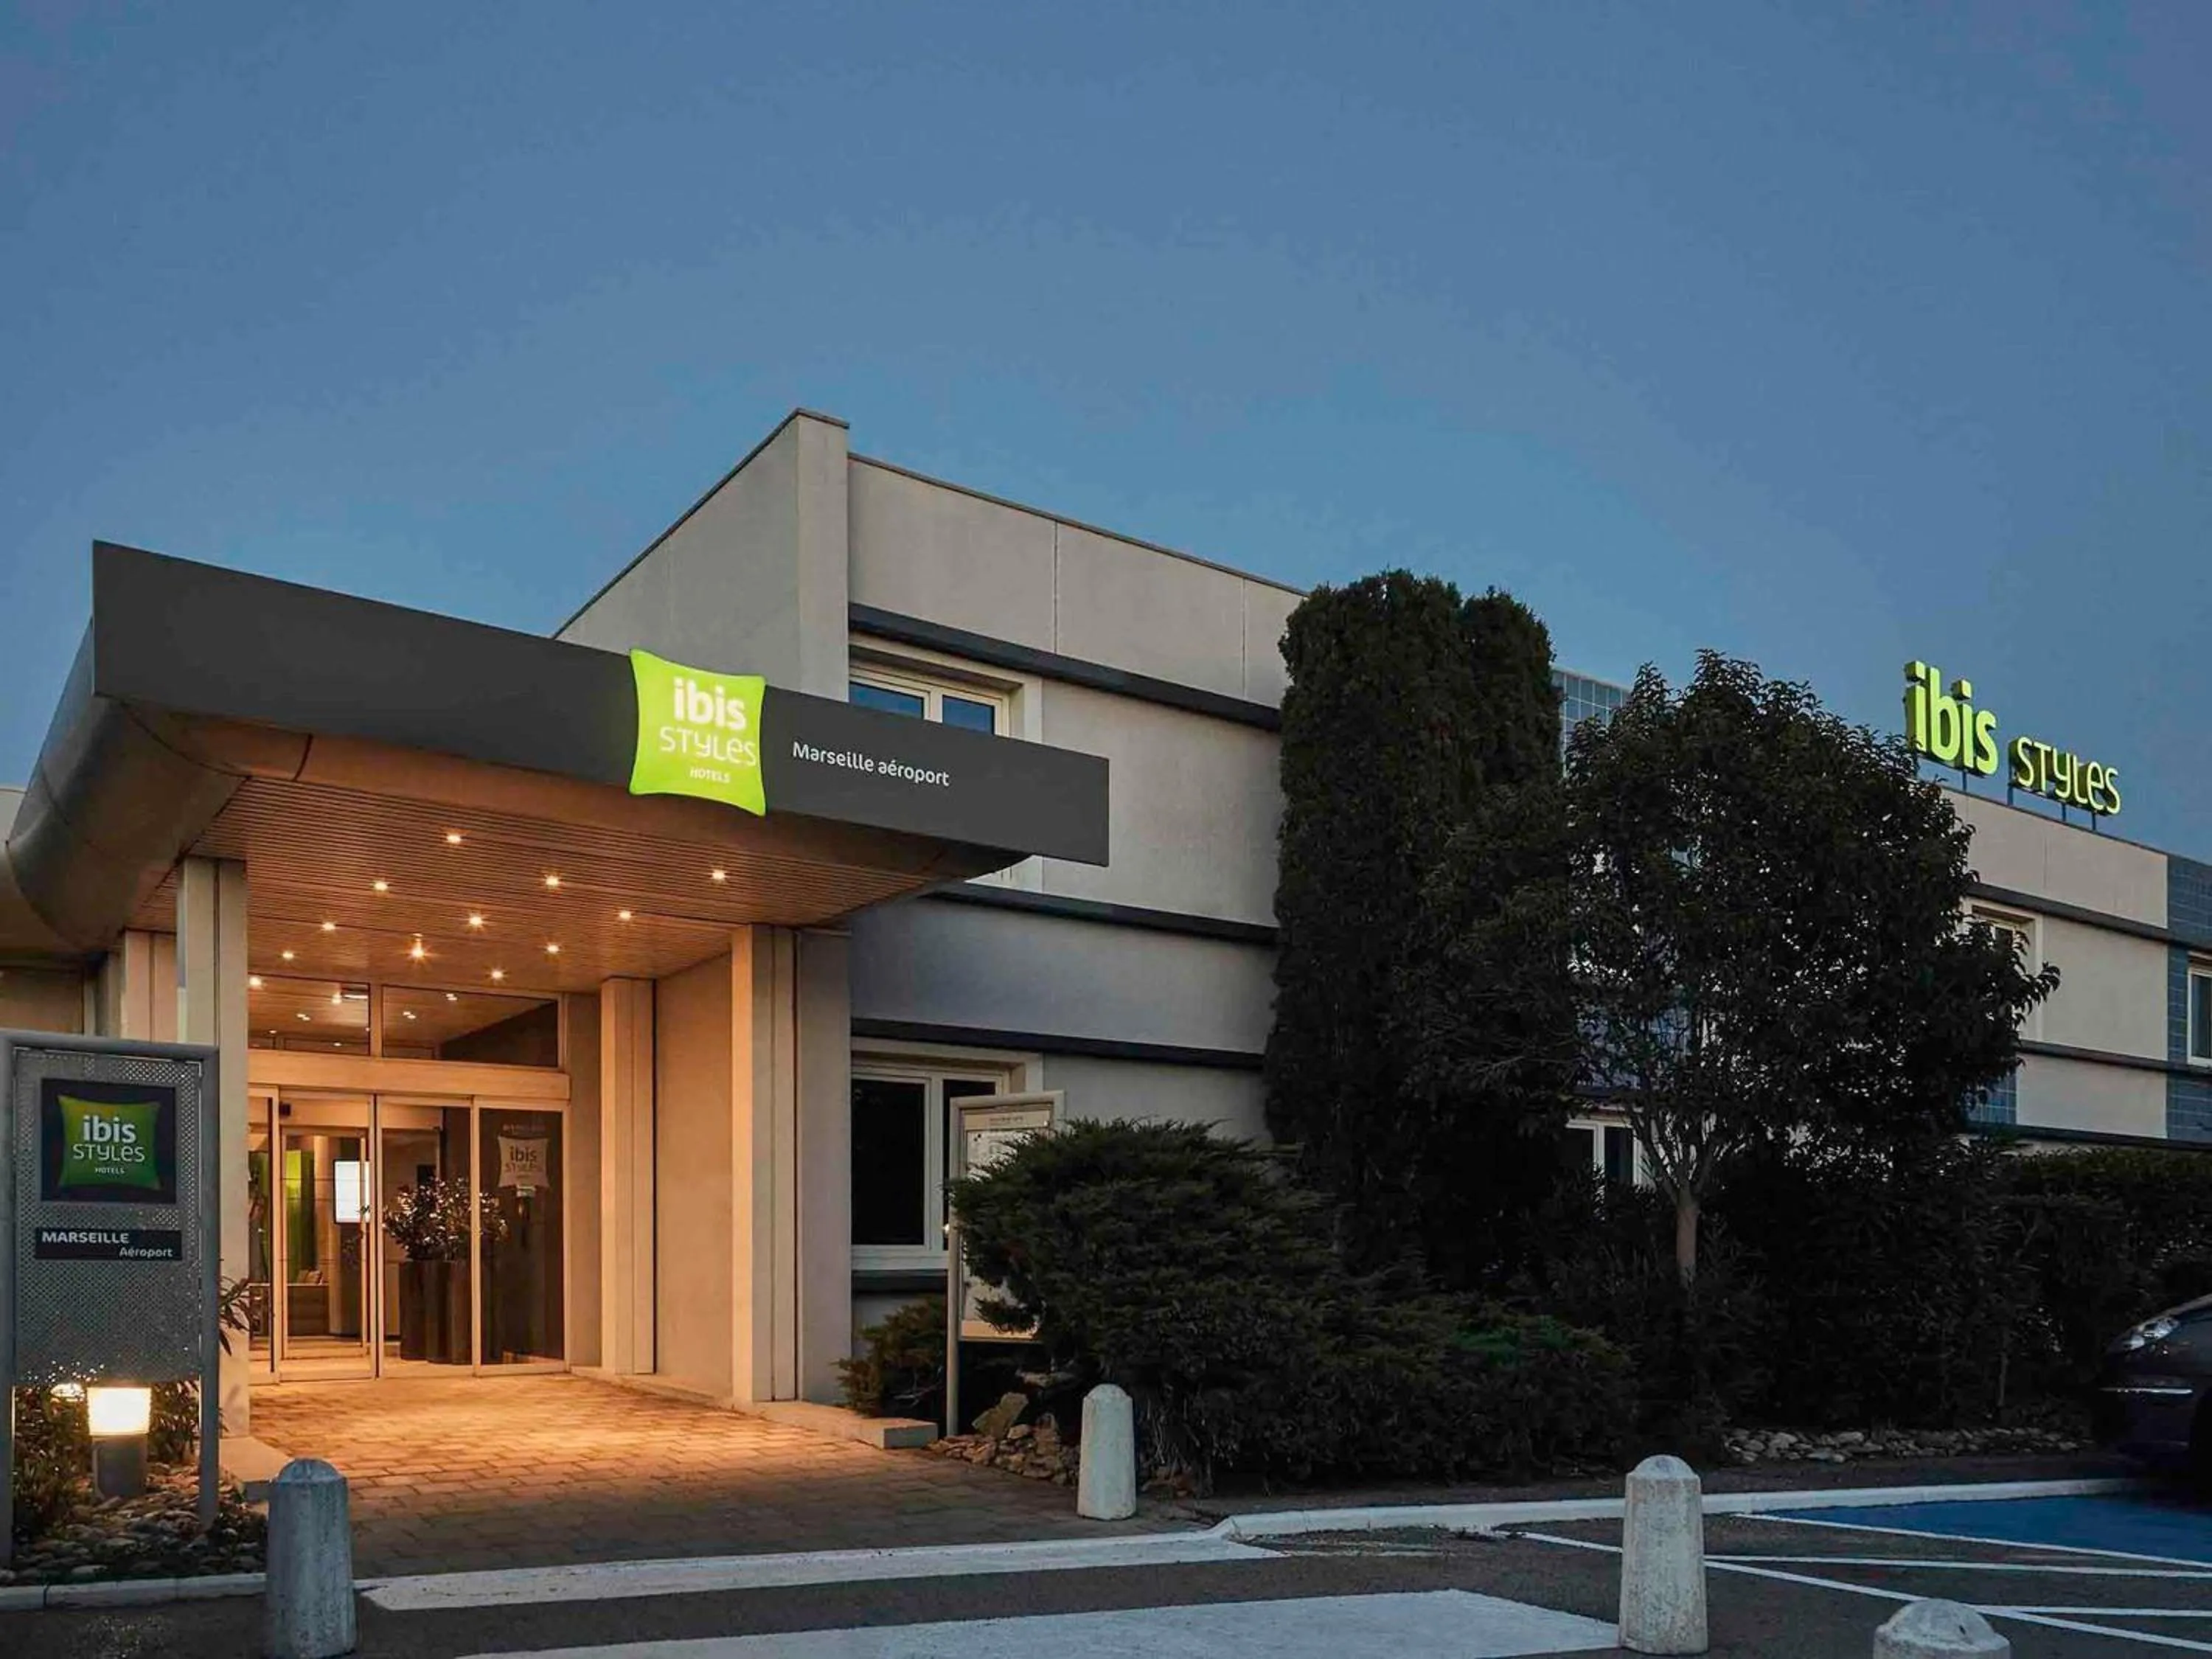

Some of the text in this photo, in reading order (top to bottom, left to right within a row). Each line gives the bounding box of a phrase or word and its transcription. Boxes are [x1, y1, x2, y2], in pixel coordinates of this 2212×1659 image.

[674, 676, 746, 731] ibis
[1905, 661, 1999, 775] ibis
[690, 767, 730, 784] HOTELS
[793, 741, 950, 787] Marseille aéroport
[83, 1115, 136, 1144] ibis
[509, 1146, 537, 1163] ibis
[42, 1231, 129, 1244] MARSEILLE
